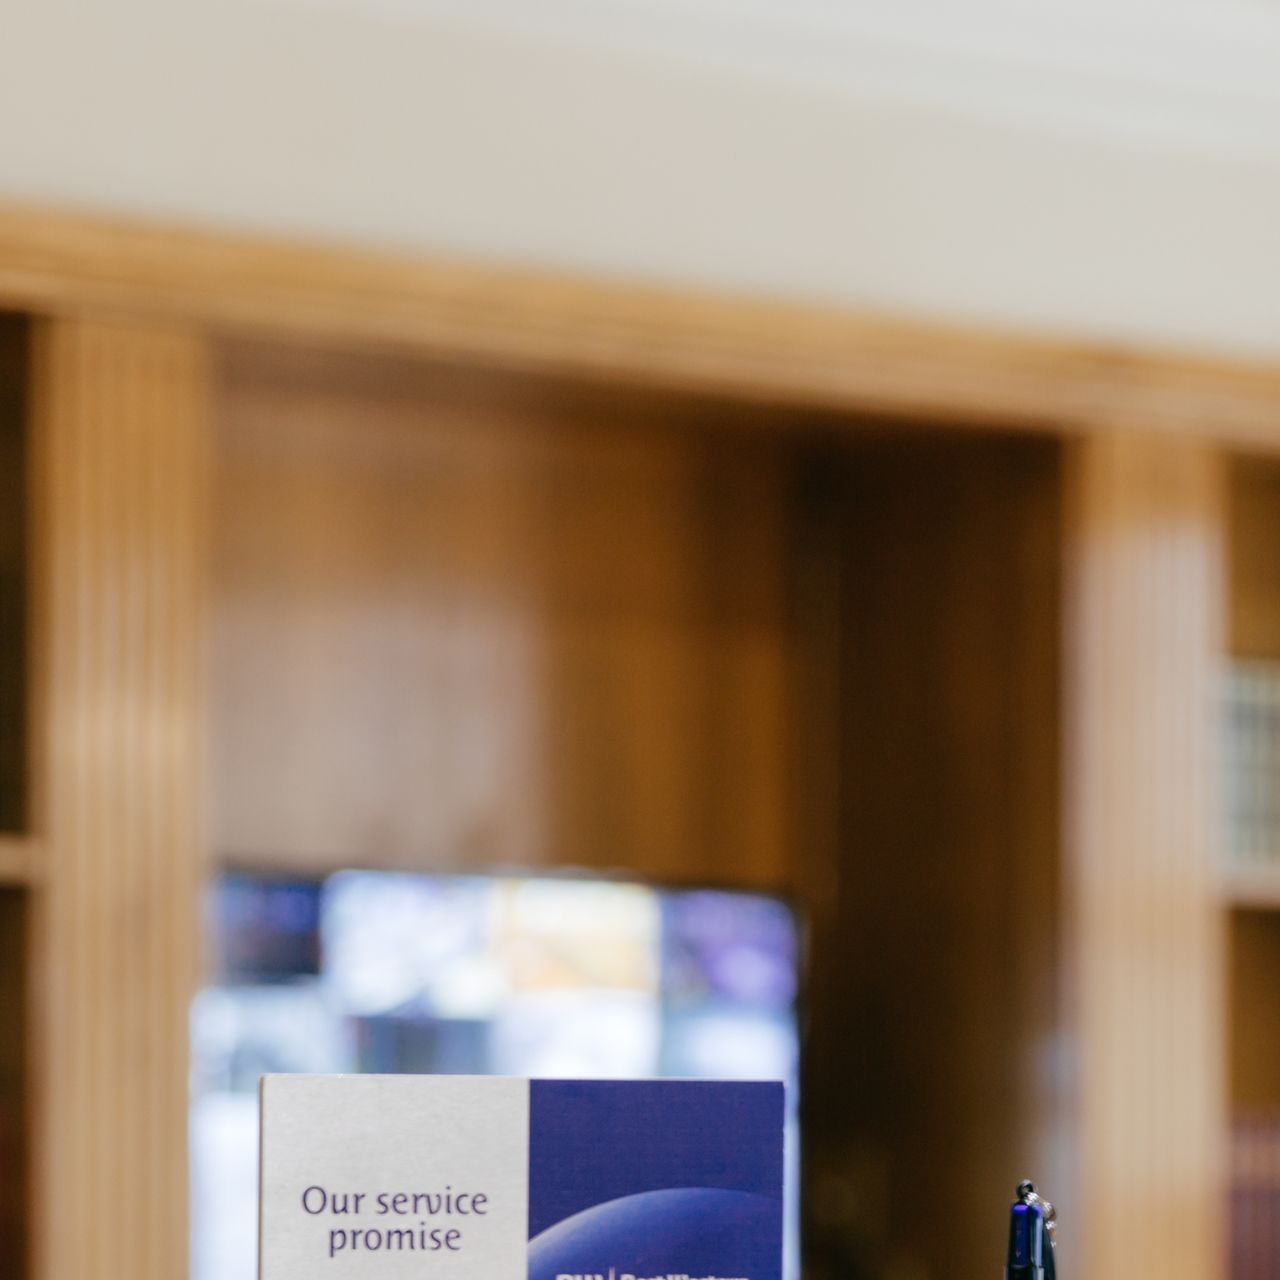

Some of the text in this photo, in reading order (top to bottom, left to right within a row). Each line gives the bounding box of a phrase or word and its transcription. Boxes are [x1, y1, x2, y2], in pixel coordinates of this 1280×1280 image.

[302, 1186, 488, 1215] Our service
[329, 1221, 461, 1258] promise
